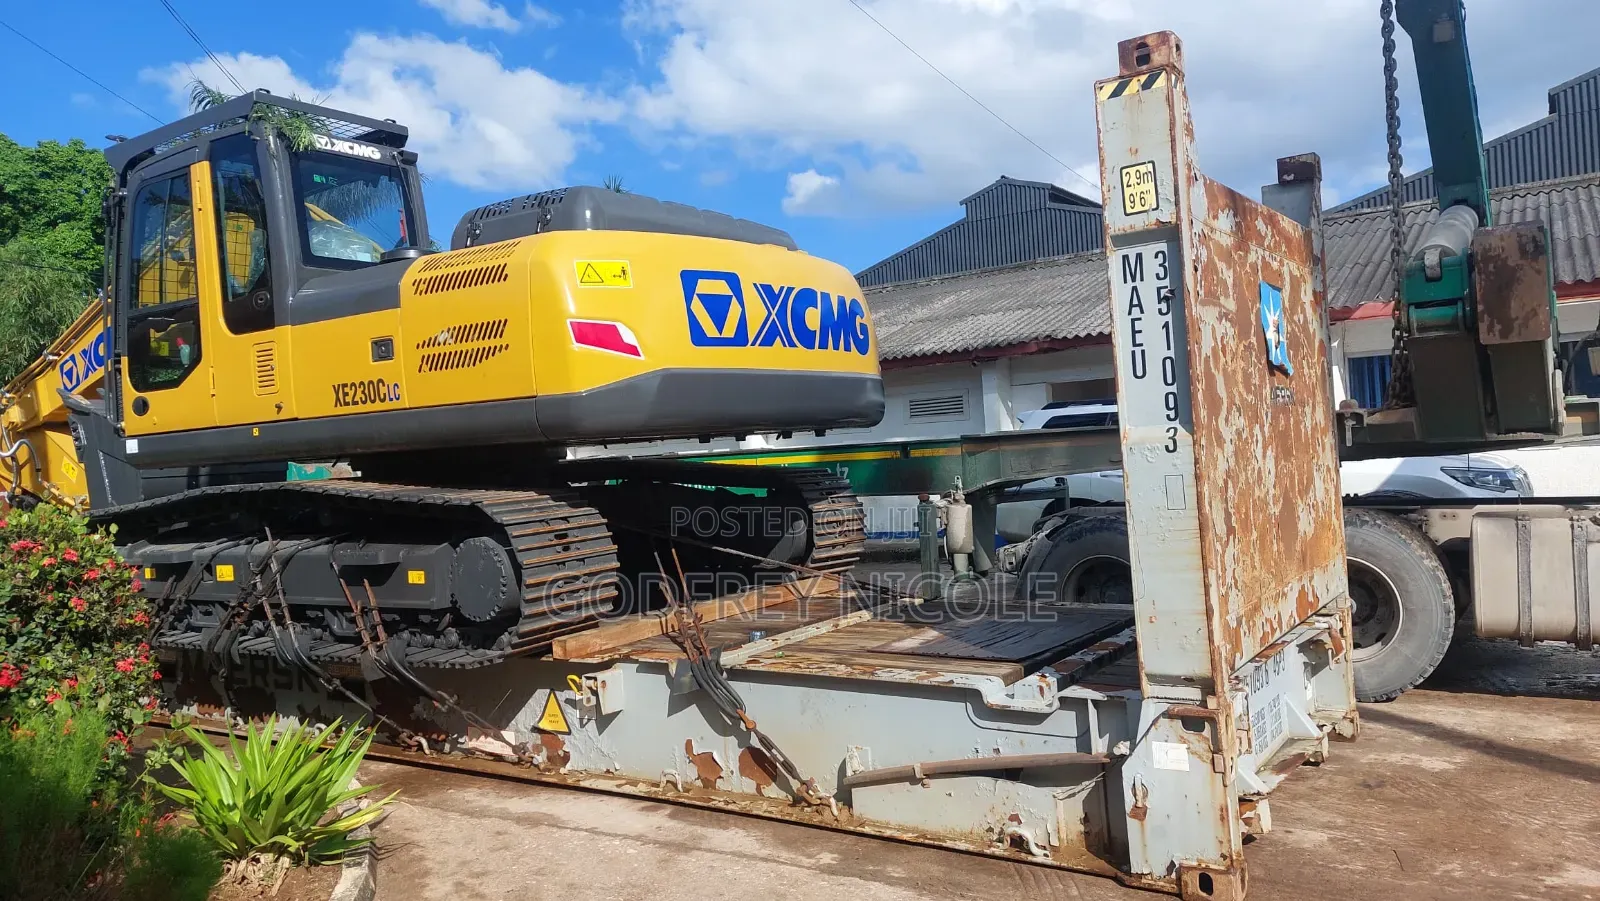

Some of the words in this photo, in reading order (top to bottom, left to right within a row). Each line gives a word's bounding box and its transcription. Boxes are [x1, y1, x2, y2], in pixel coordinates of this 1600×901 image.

[331, 138, 382, 160] XCMG
[1124, 170, 1153, 189] 2,9m
[750, 282, 870, 356] XCMG
[1121, 252, 1148, 380] MAEU
[1154, 250, 1180, 454] 351093
